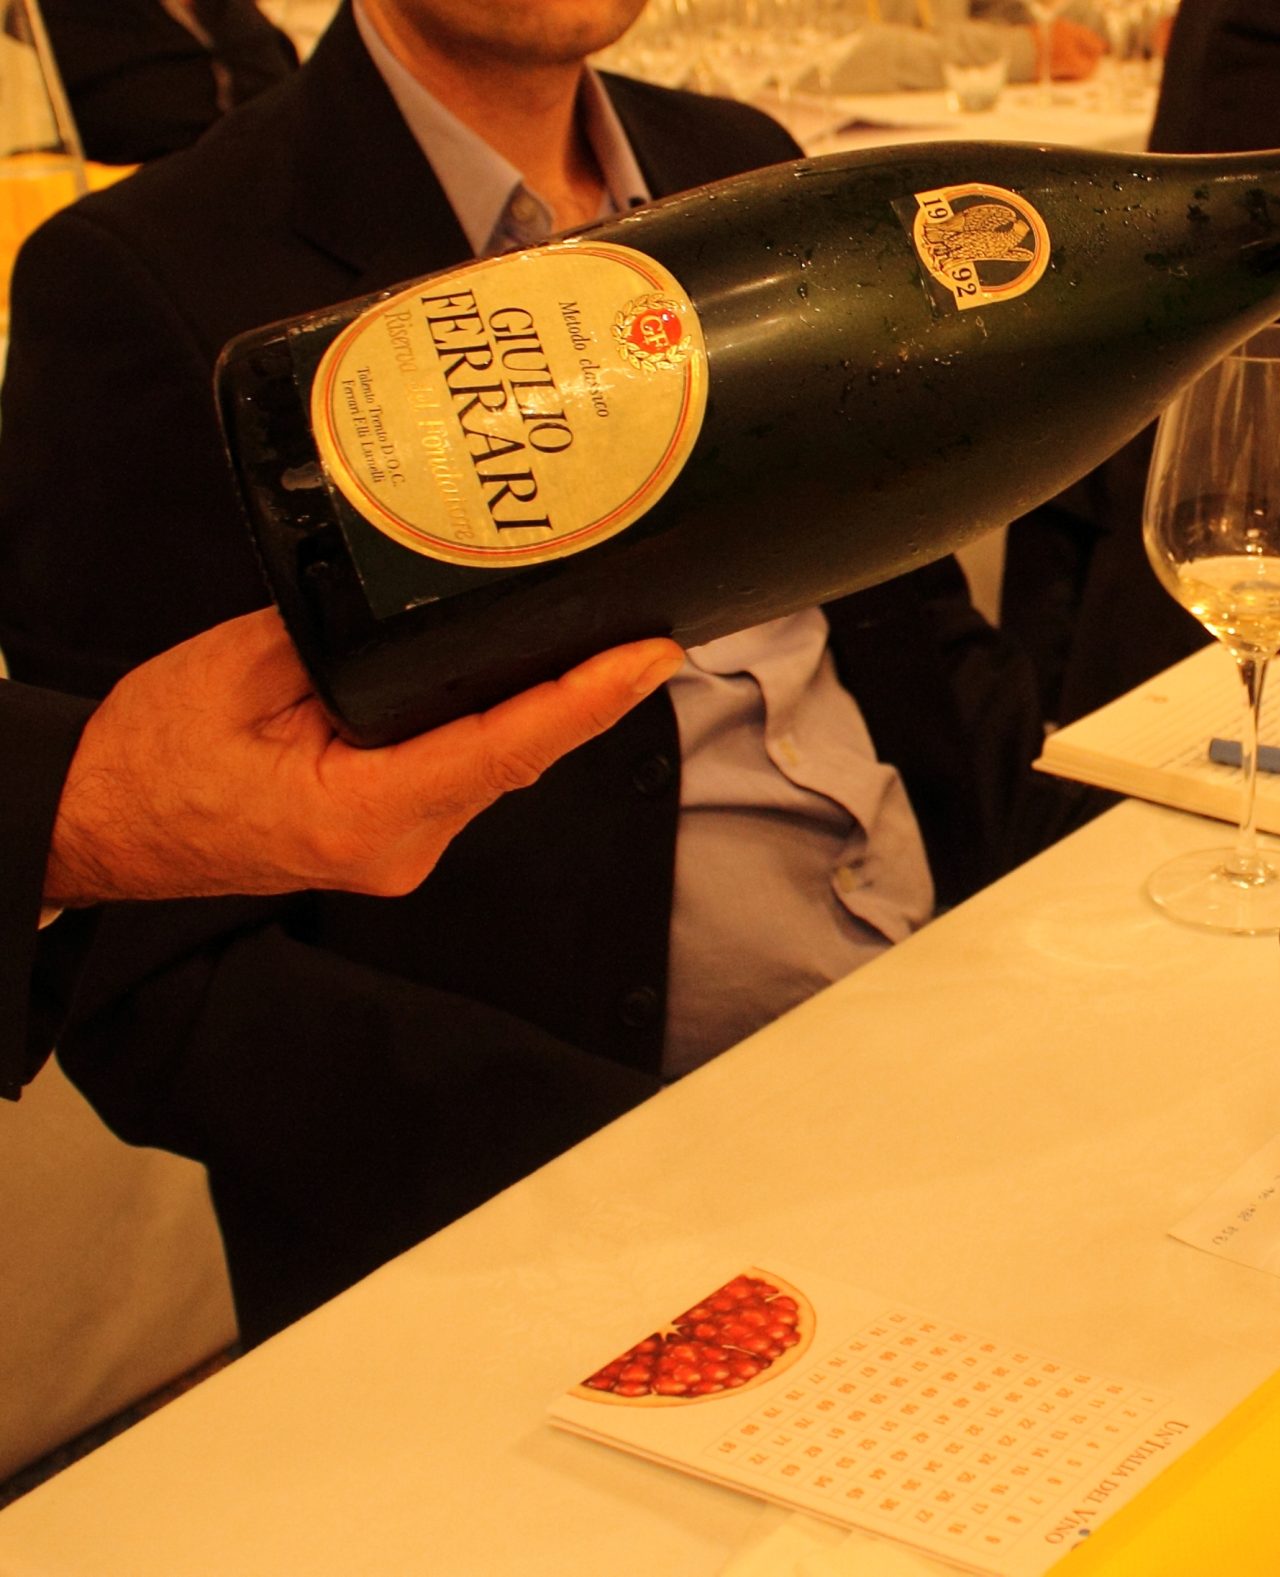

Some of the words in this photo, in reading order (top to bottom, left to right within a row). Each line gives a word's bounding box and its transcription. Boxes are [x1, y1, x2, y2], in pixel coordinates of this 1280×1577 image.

[923, 198, 948, 220] 19
[952, 267, 978, 298] 92
[384, 308, 418, 374] Riserva
[488, 306, 574, 454] GIULIO
[558, 301, 591, 351] Metodo
[579, 359, 609, 417] classico
[640, 315, 669, 347] GF
[341, 379, 360, 416] Ferrari
[361, 441, 385, 484] Lunelli
[357, 366, 375, 404] Talento
[368, 404, 387, 442] Trento
[420, 288, 554, 535] FERRARI
